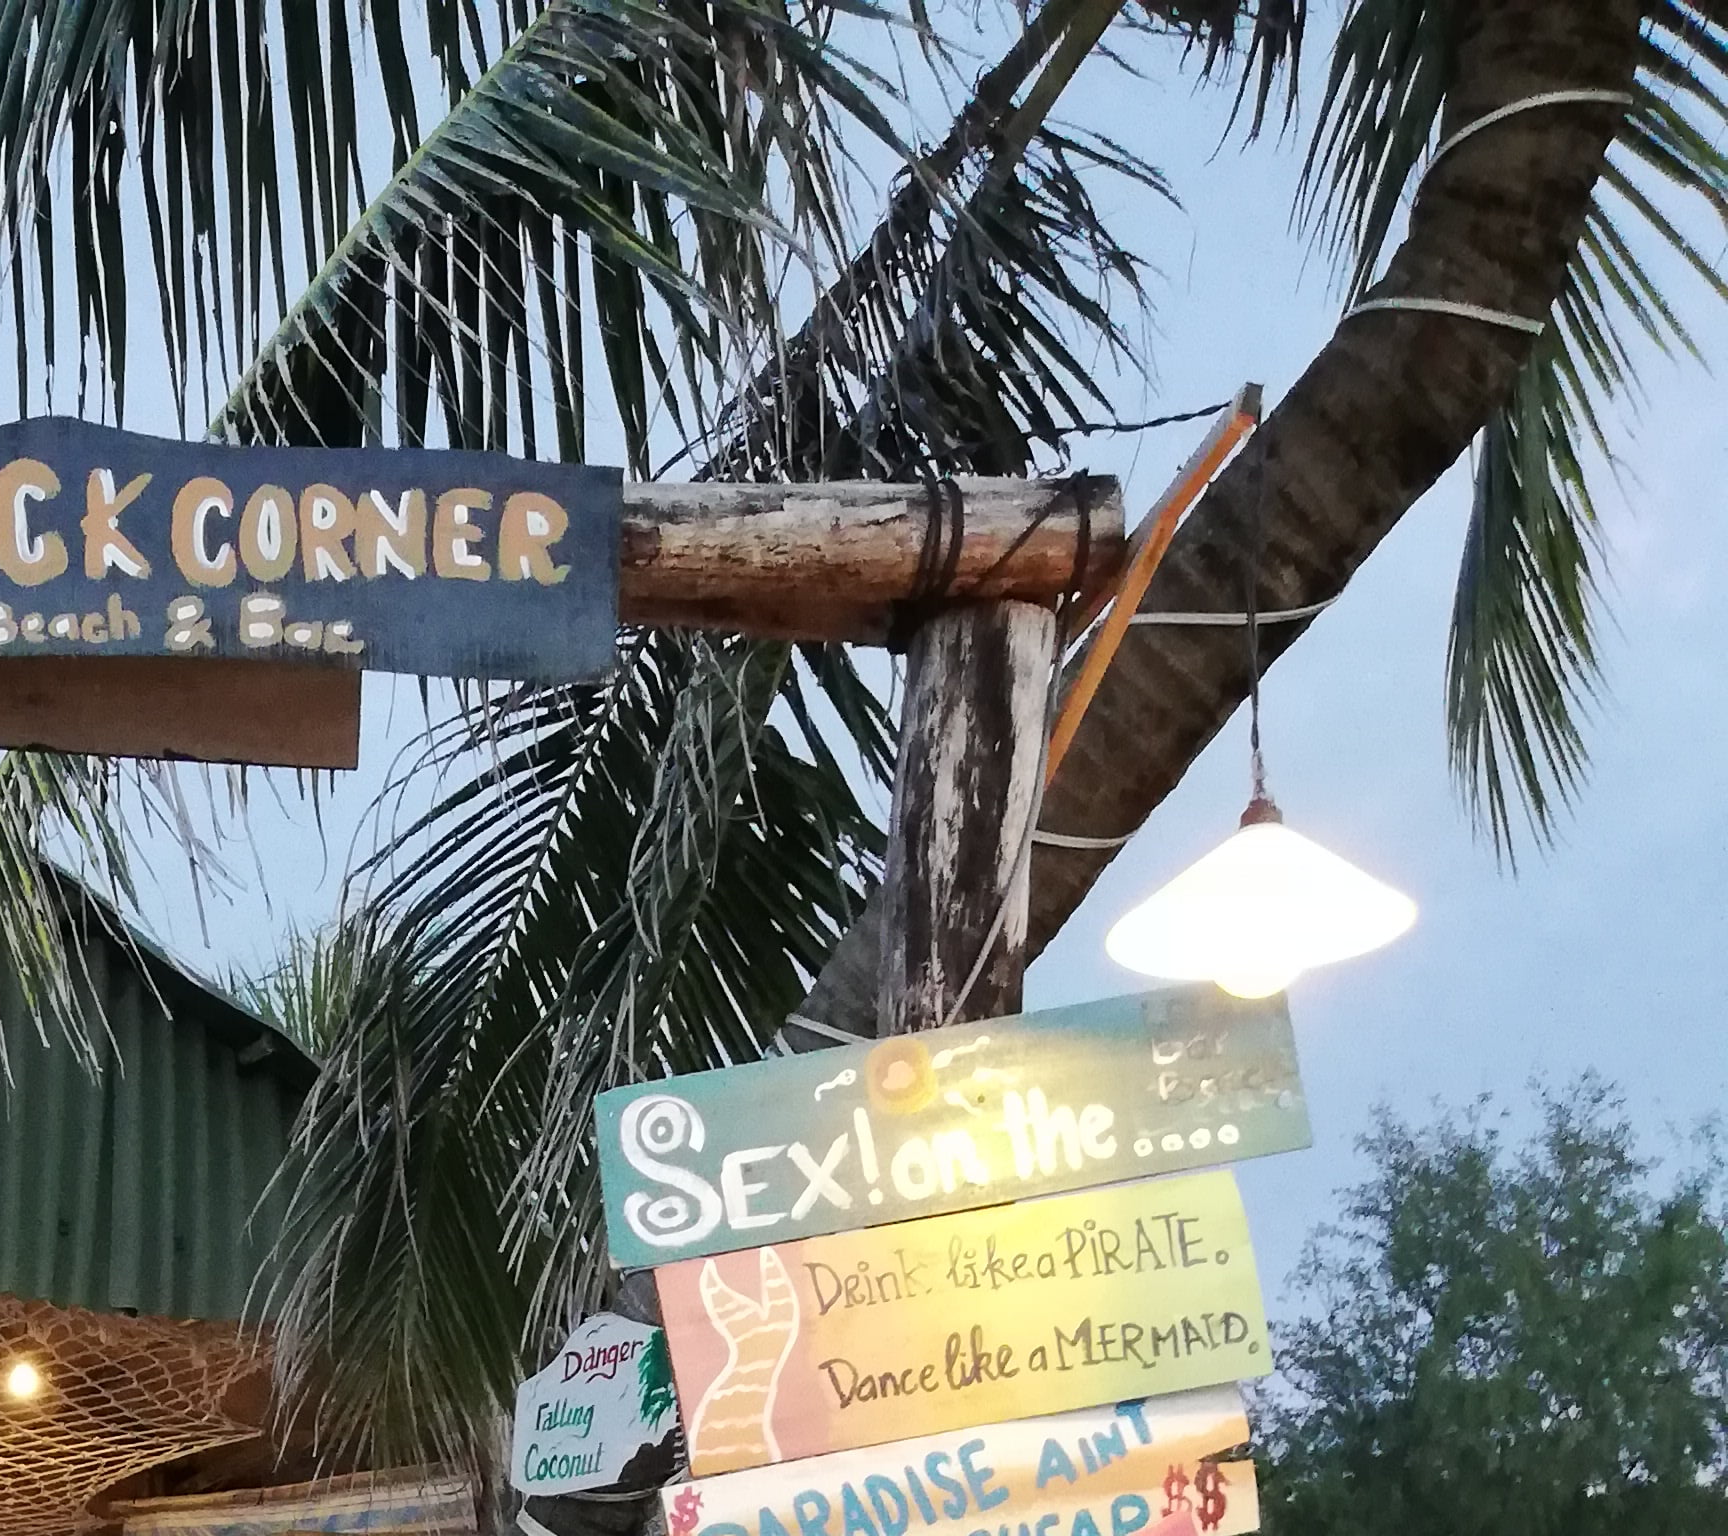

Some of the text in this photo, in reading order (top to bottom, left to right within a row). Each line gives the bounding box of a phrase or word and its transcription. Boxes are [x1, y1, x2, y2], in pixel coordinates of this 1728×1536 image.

[172, 478, 572, 585] CORNER
[162, 595, 216, 653] &
[892, 1126, 989, 1201] on
[560, 1340, 644, 1384] Danger
[819, 1357, 939, 1409] Dance
[945, 1323, 1020, 1393] like
[536, 1398, 595, 1438] Falling
[1036, 1400, 1152, 1490] AINT
[524, 1441, 603, 1483] Coconut
